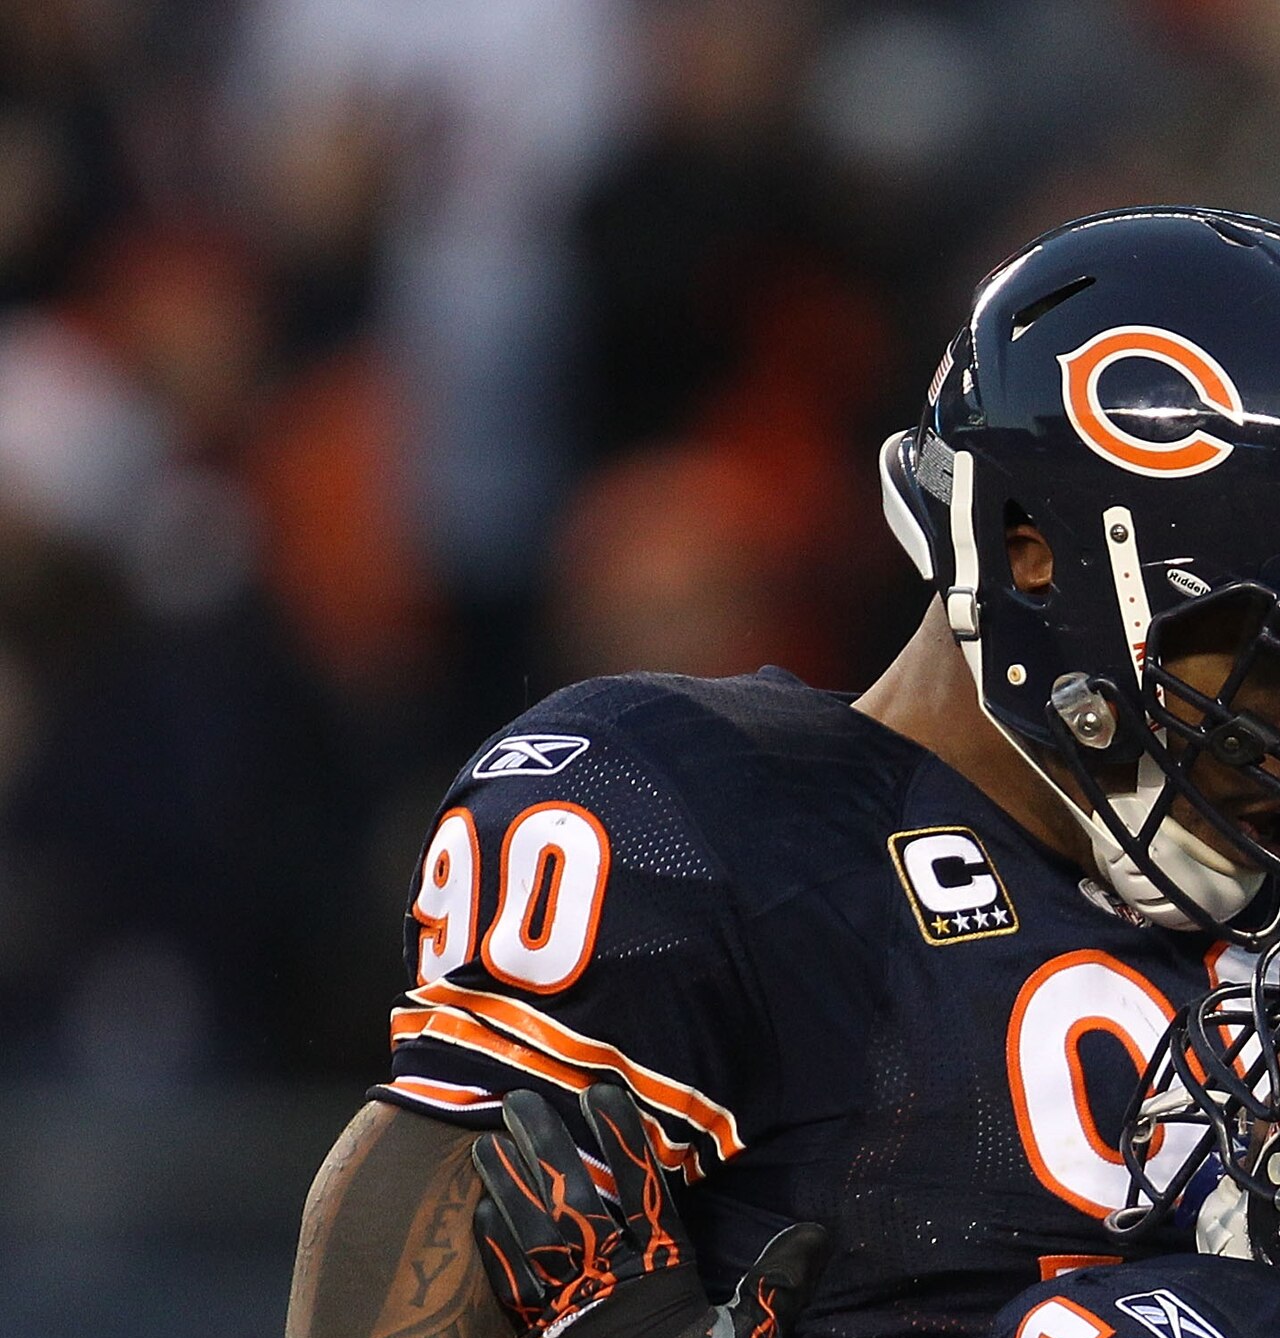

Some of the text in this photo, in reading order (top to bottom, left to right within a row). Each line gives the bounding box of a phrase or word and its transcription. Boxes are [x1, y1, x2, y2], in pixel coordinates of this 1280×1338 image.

[1056, 325, 1244, 479] C
[412, 800, 612, 995] 90
[904, 834, 998, 913] C
